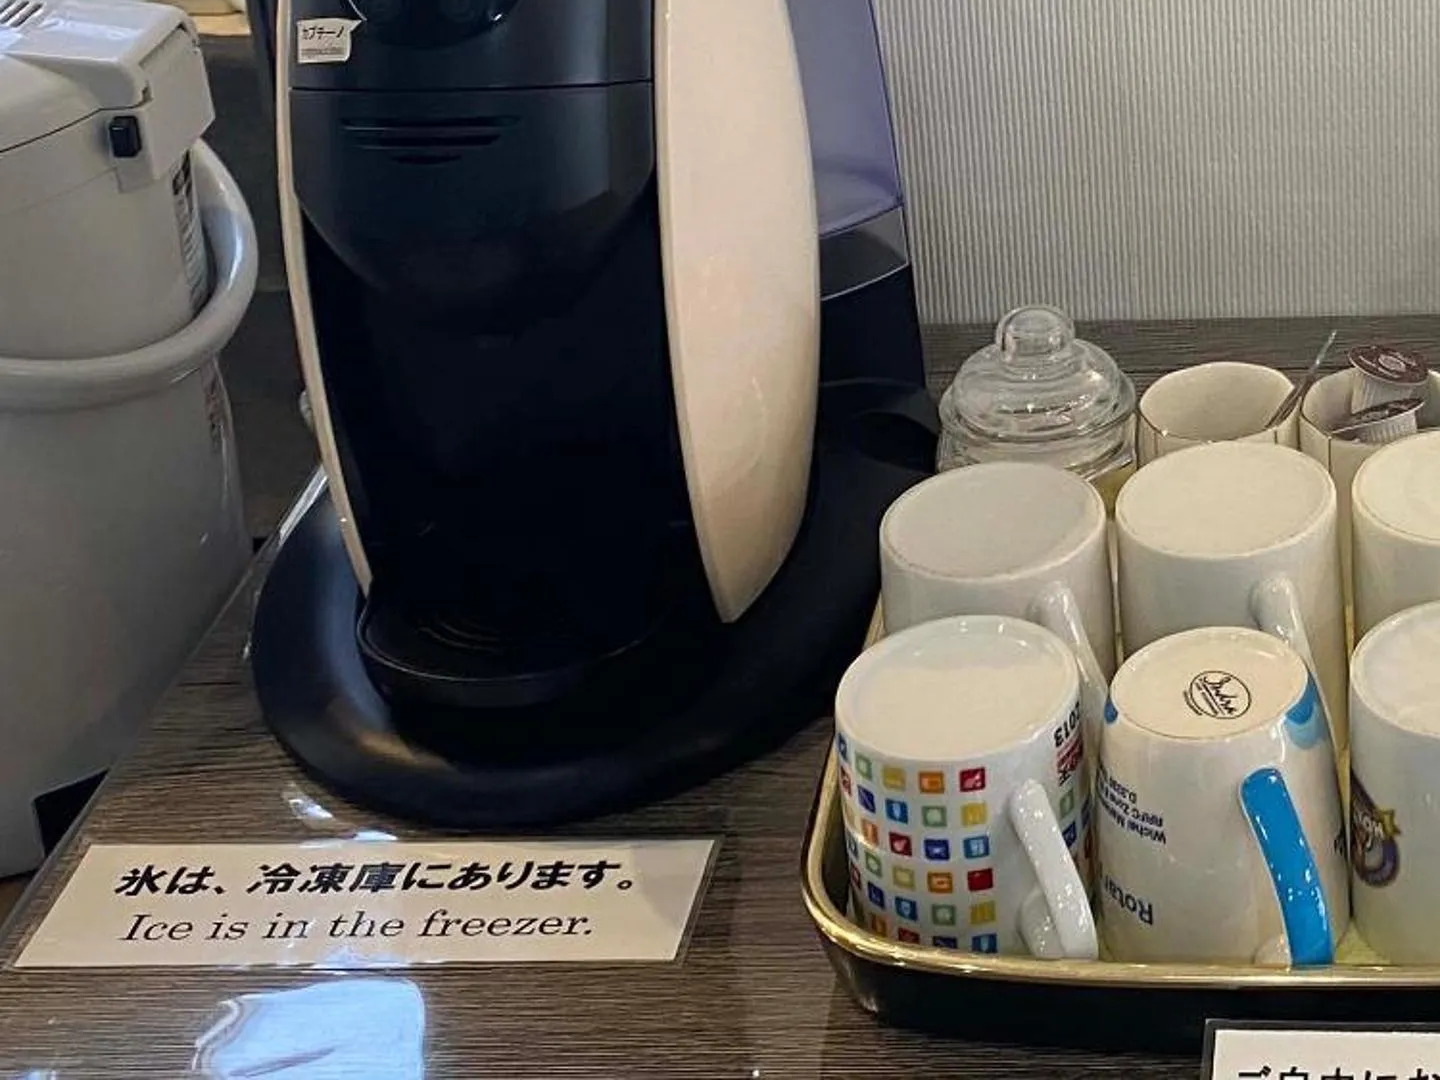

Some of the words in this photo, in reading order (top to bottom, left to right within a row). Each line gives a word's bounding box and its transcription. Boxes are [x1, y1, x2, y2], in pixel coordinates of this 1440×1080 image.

[114, 859, 637, 897] 氷は、冷凍庫にあります。
[118, 913, 194, 942] Ice
[205, 913, 248, 942] is
[263, 911, 309, 939] in
[327, 910, 406, 939] the
[416, 908, 594, 939] freezer.
